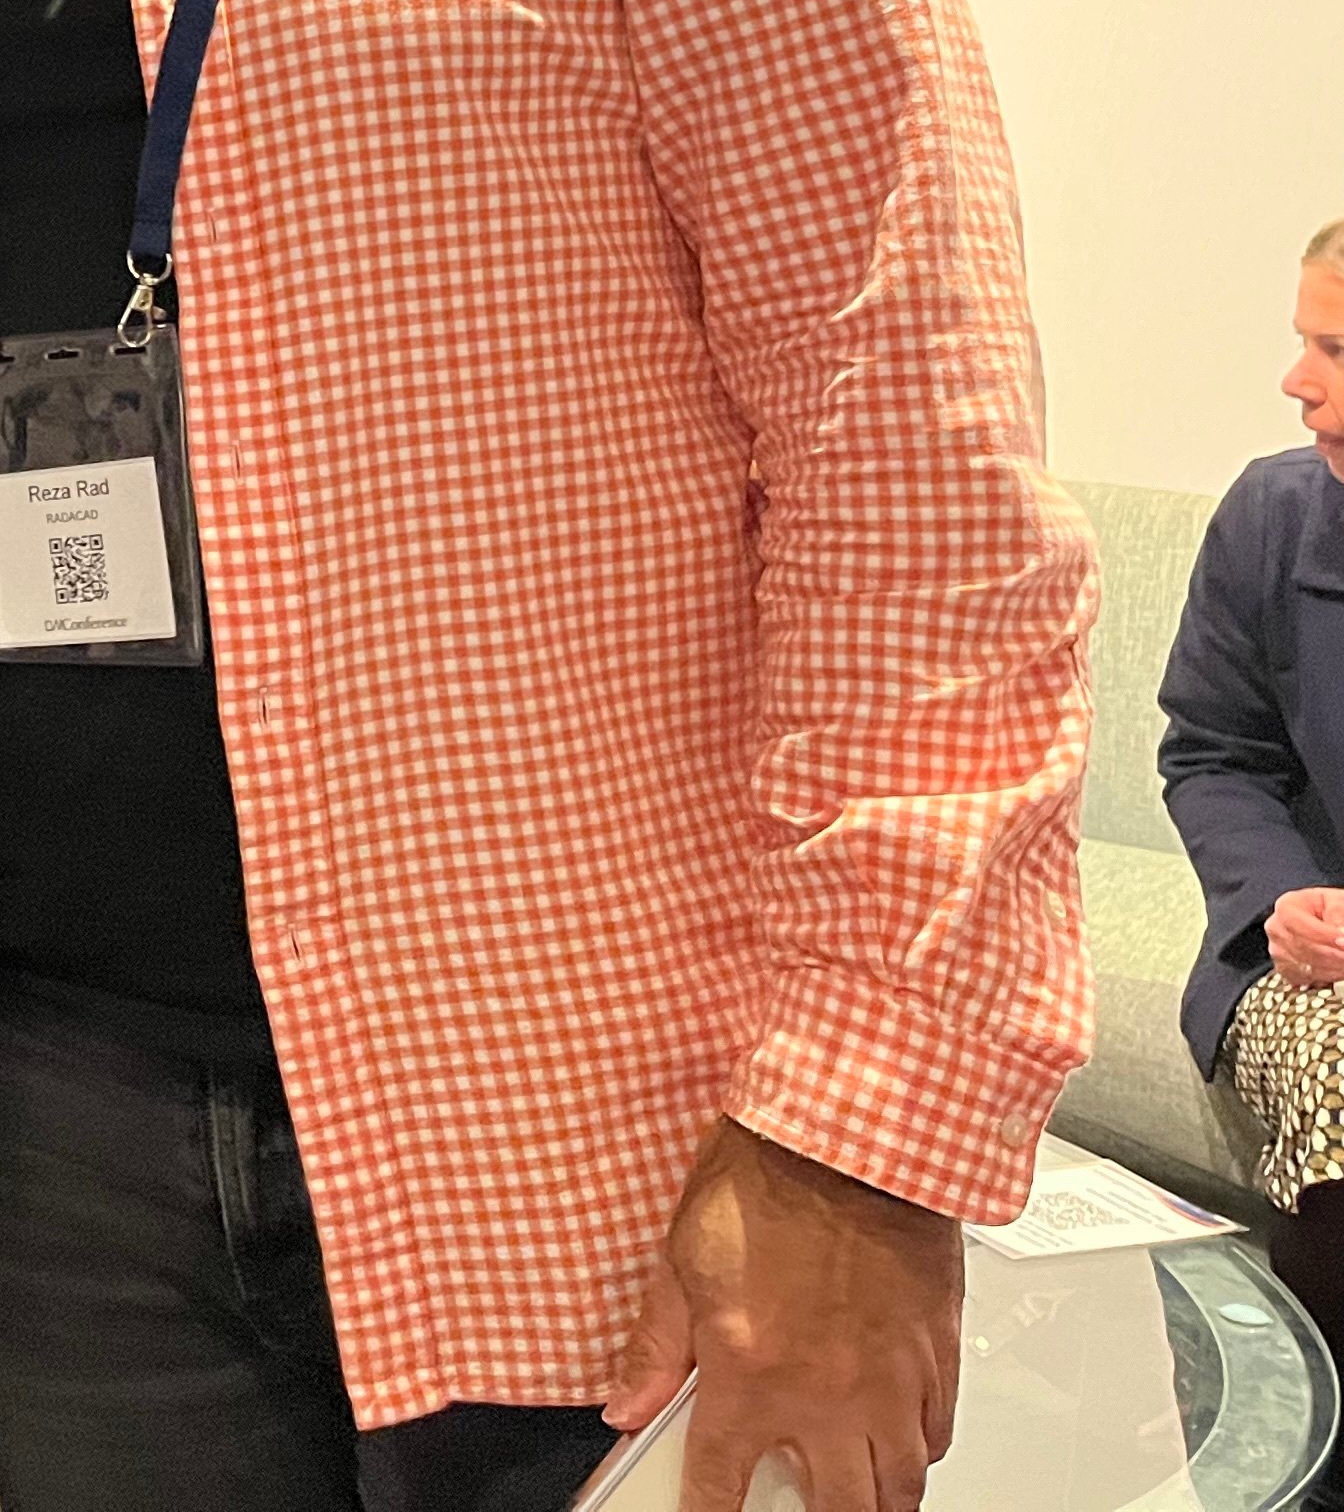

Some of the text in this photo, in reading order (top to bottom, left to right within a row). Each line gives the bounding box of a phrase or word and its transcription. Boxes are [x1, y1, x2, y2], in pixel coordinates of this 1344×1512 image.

[29, 478, 110, 503] Reza Rad
[46, 510, 98, 524] RADACAD
